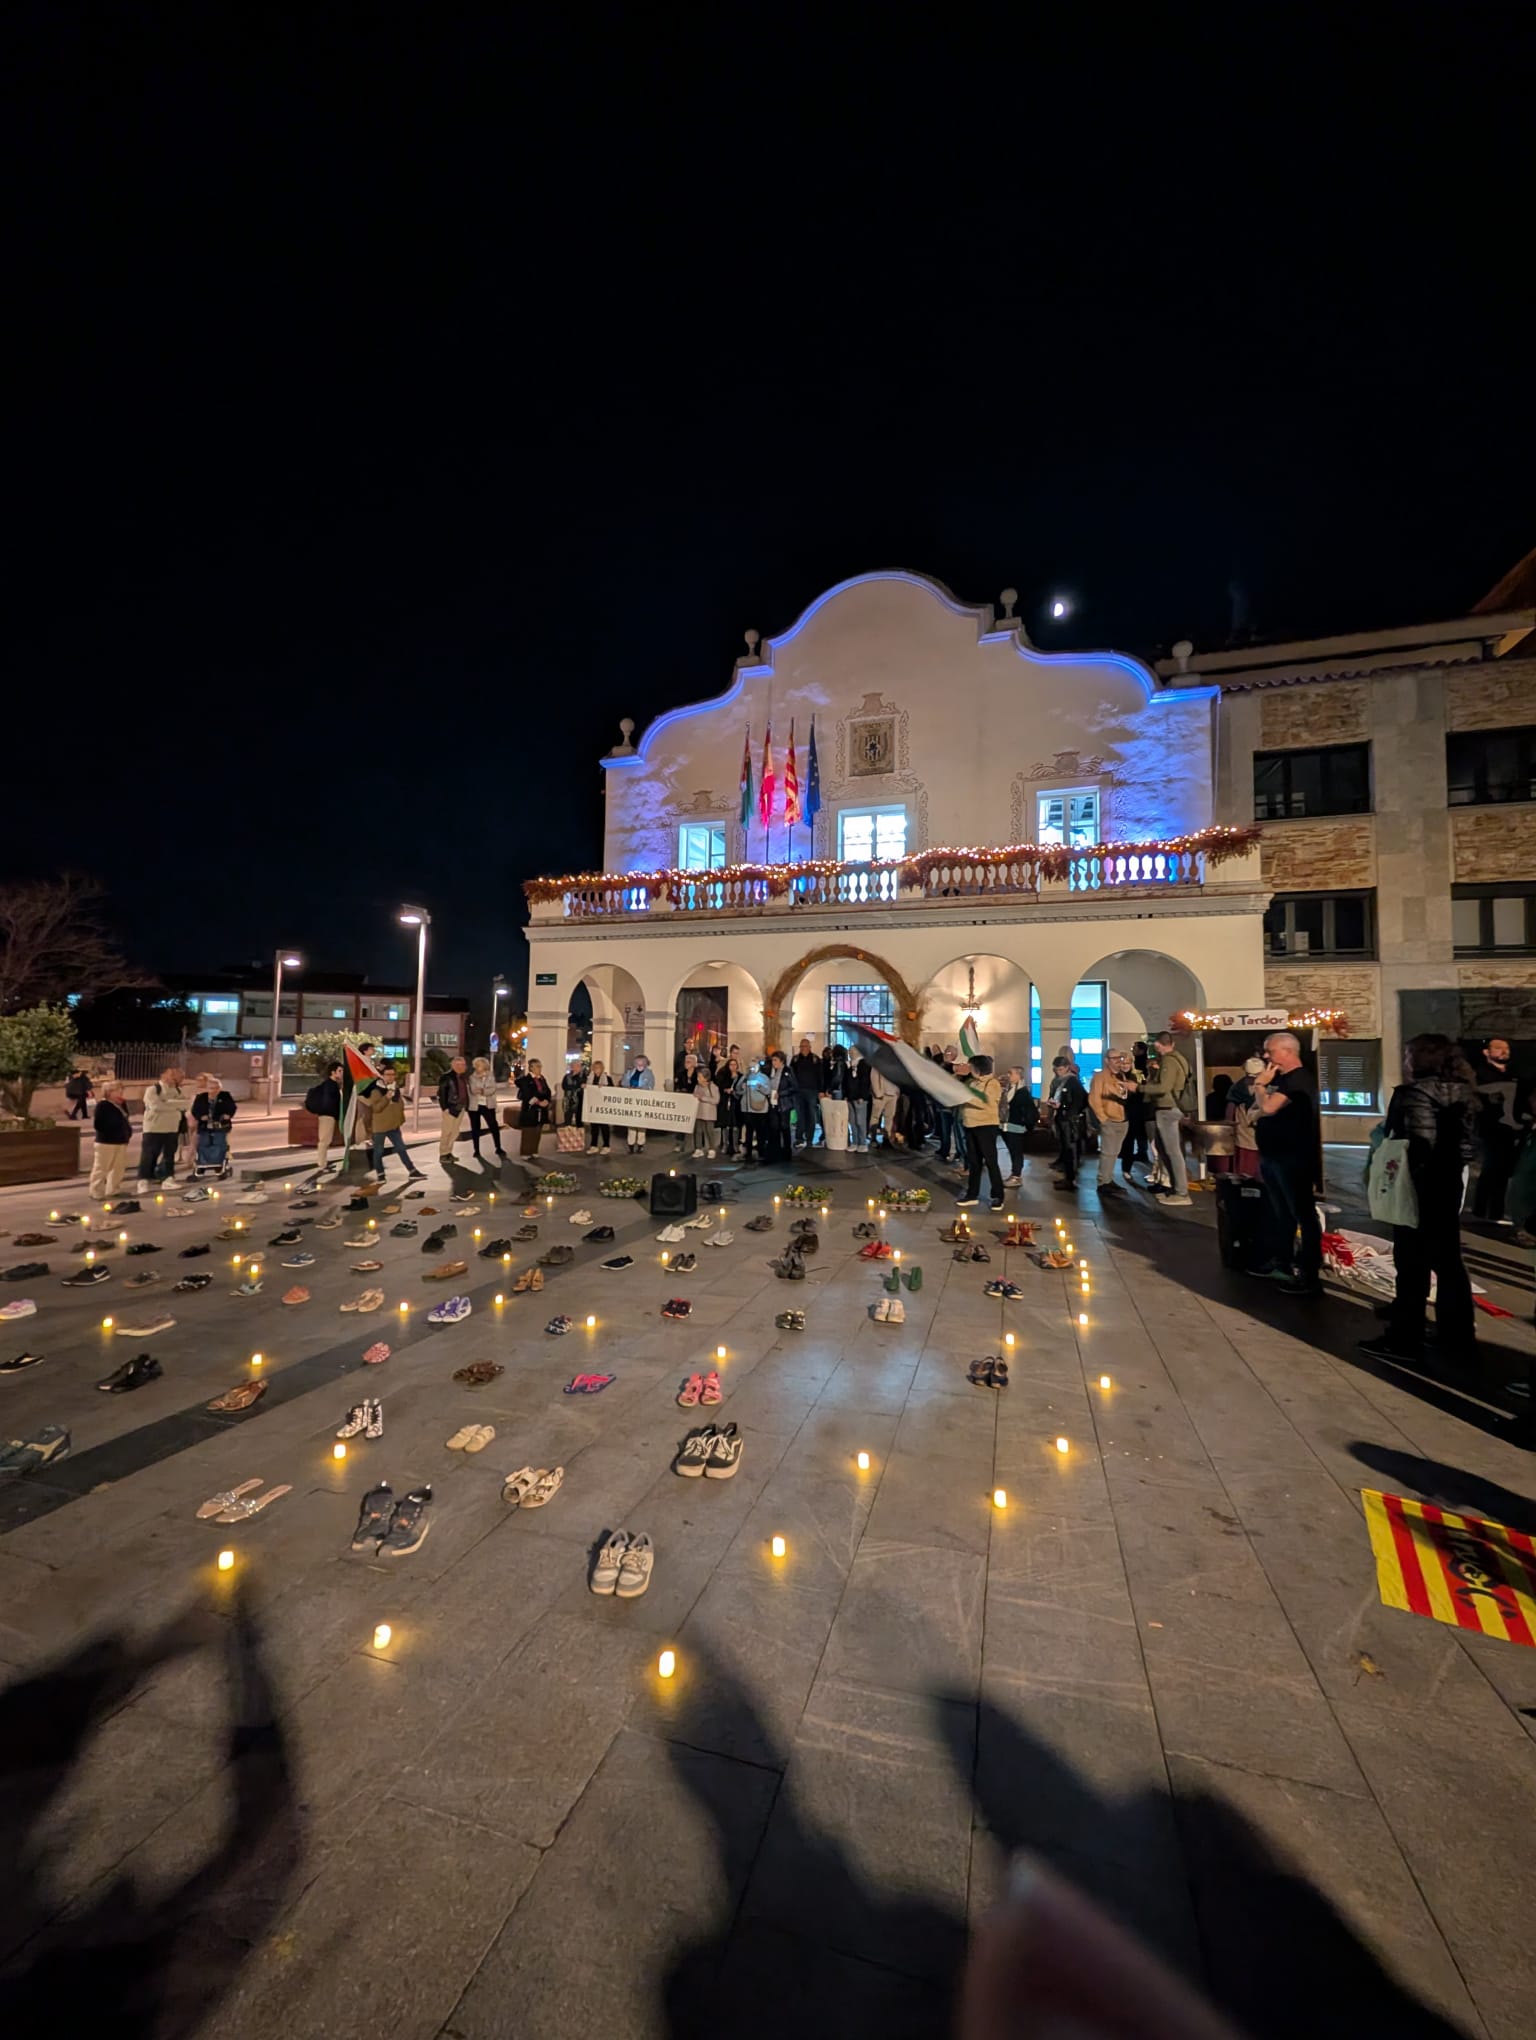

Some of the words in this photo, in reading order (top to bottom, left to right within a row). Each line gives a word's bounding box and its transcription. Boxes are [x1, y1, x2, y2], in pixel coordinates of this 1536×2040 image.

[1222, 1016, 1234, 1026] La
[1237, 1014, 1285, 1026] Tardor
[603, 1095, 622, 1104] PROU
[624, 1097, 633, 1105] DE
[635, 1097, 676, 1109] VIOLÈNCIES
[595, 1107, 642, 1118] ASSASSINATS
